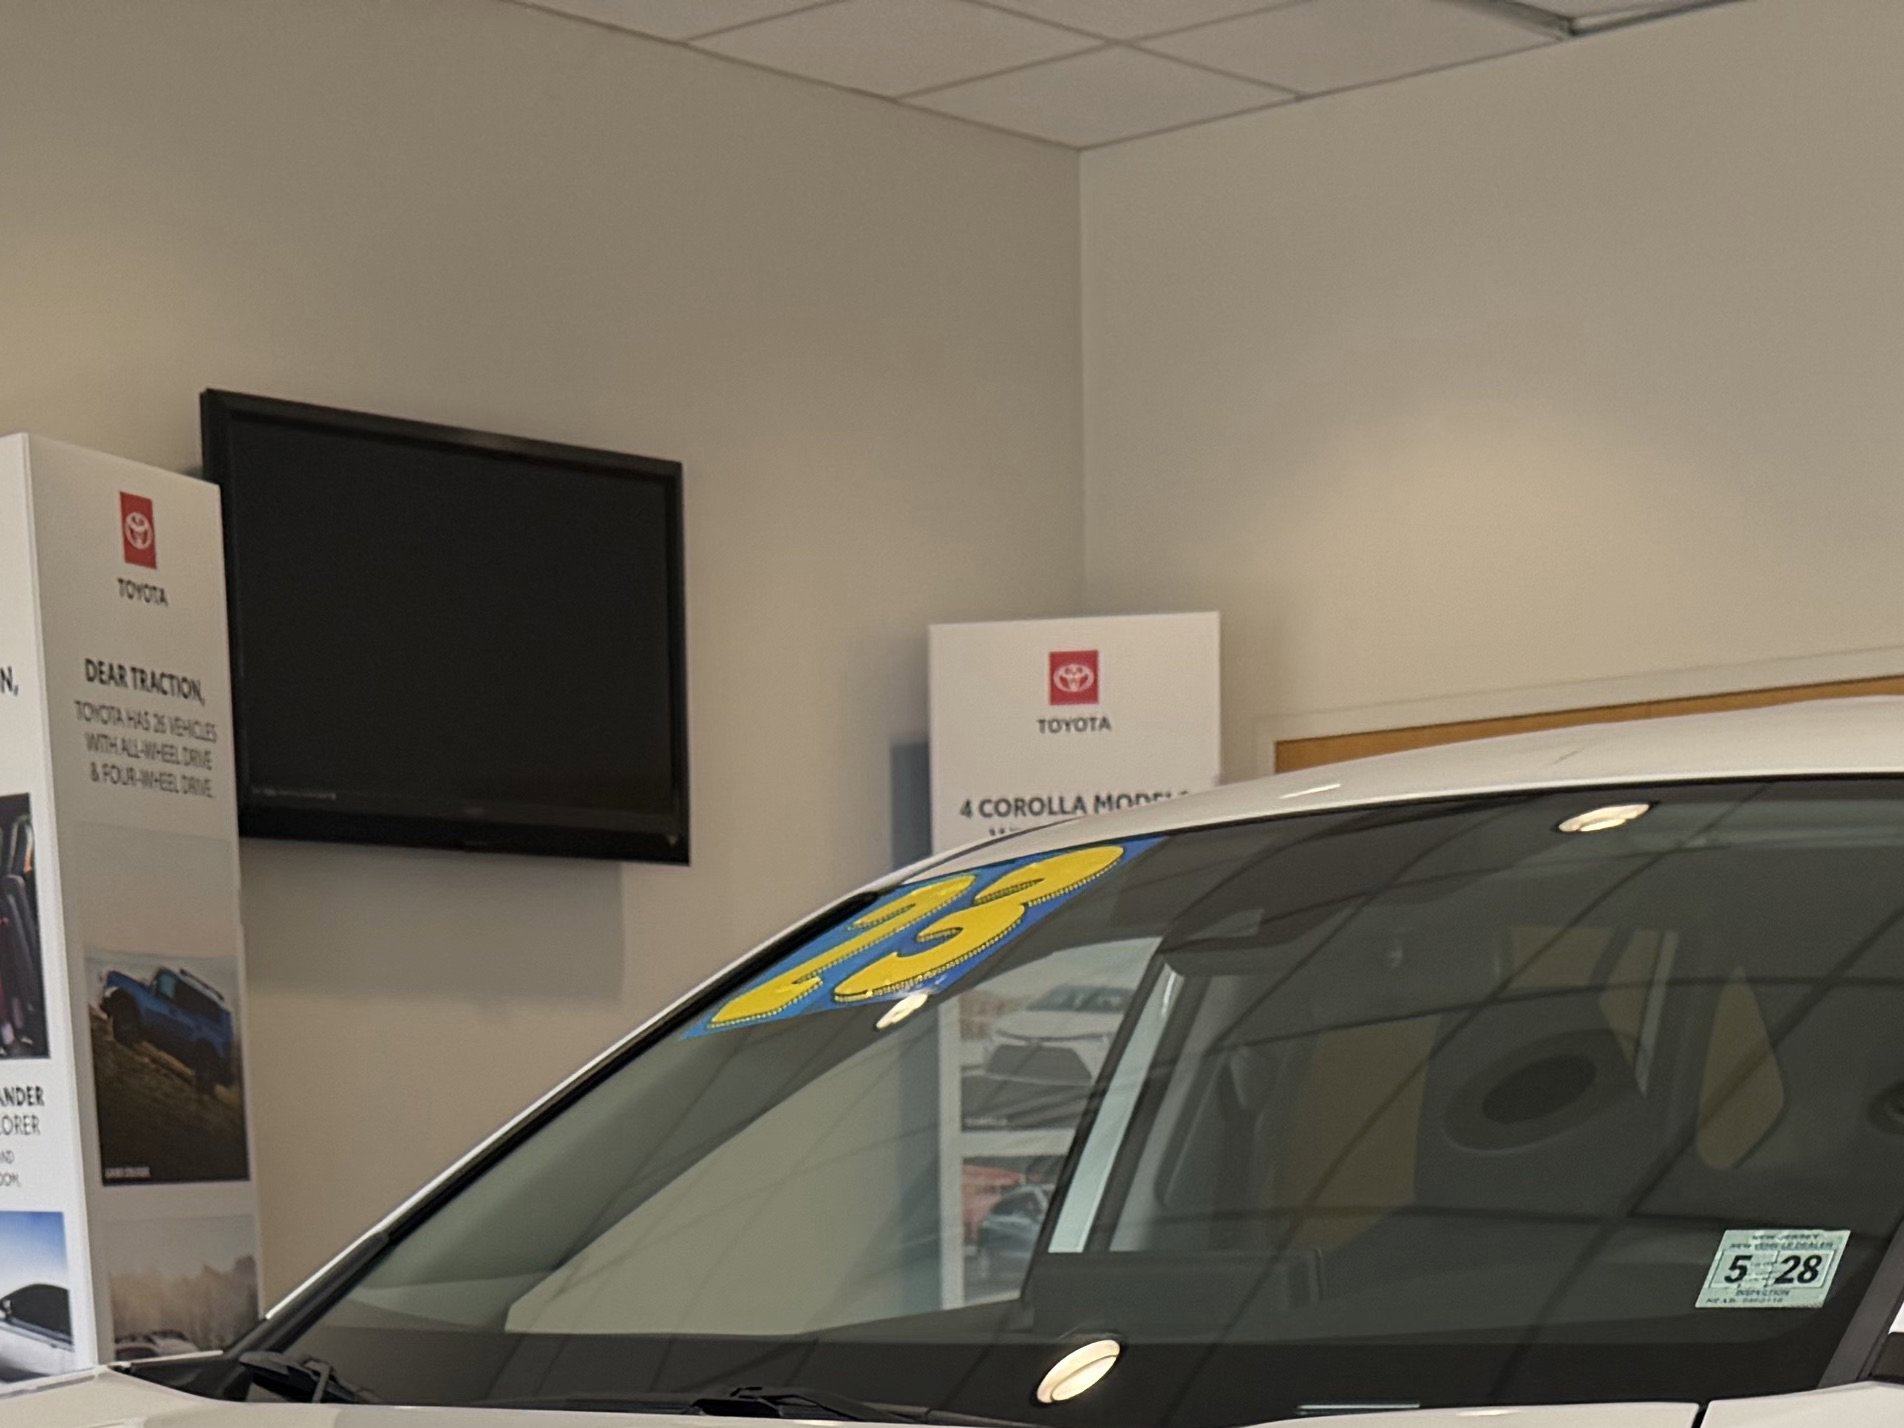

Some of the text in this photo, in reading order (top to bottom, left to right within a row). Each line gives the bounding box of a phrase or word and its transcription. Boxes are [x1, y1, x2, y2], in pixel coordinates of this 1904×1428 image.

[117, 577, 169, 607] TOYOTA
[85, 657, 205, 706] DEAR TRACTION,
[74, 700, 124, 726] TOYOTA
[126, 709, 150, 731] HAS
[169, 716, 217, 743] VEHICLES
[1036, 716, 1112, 735] TOYOTA
[84, 732, 213, 771] WITH ALL-WHEEL DRIVE
[90, 761, 100, 782] &
[102, 762, 180, 794] FOUR-WHEEL
[960, 800, 973, 819] 4
[978, 795, 1089, 819] COROLLA
[1724, 1254, 1754, 1284] 5
[1773, 1254, 1823, 1285] 28
